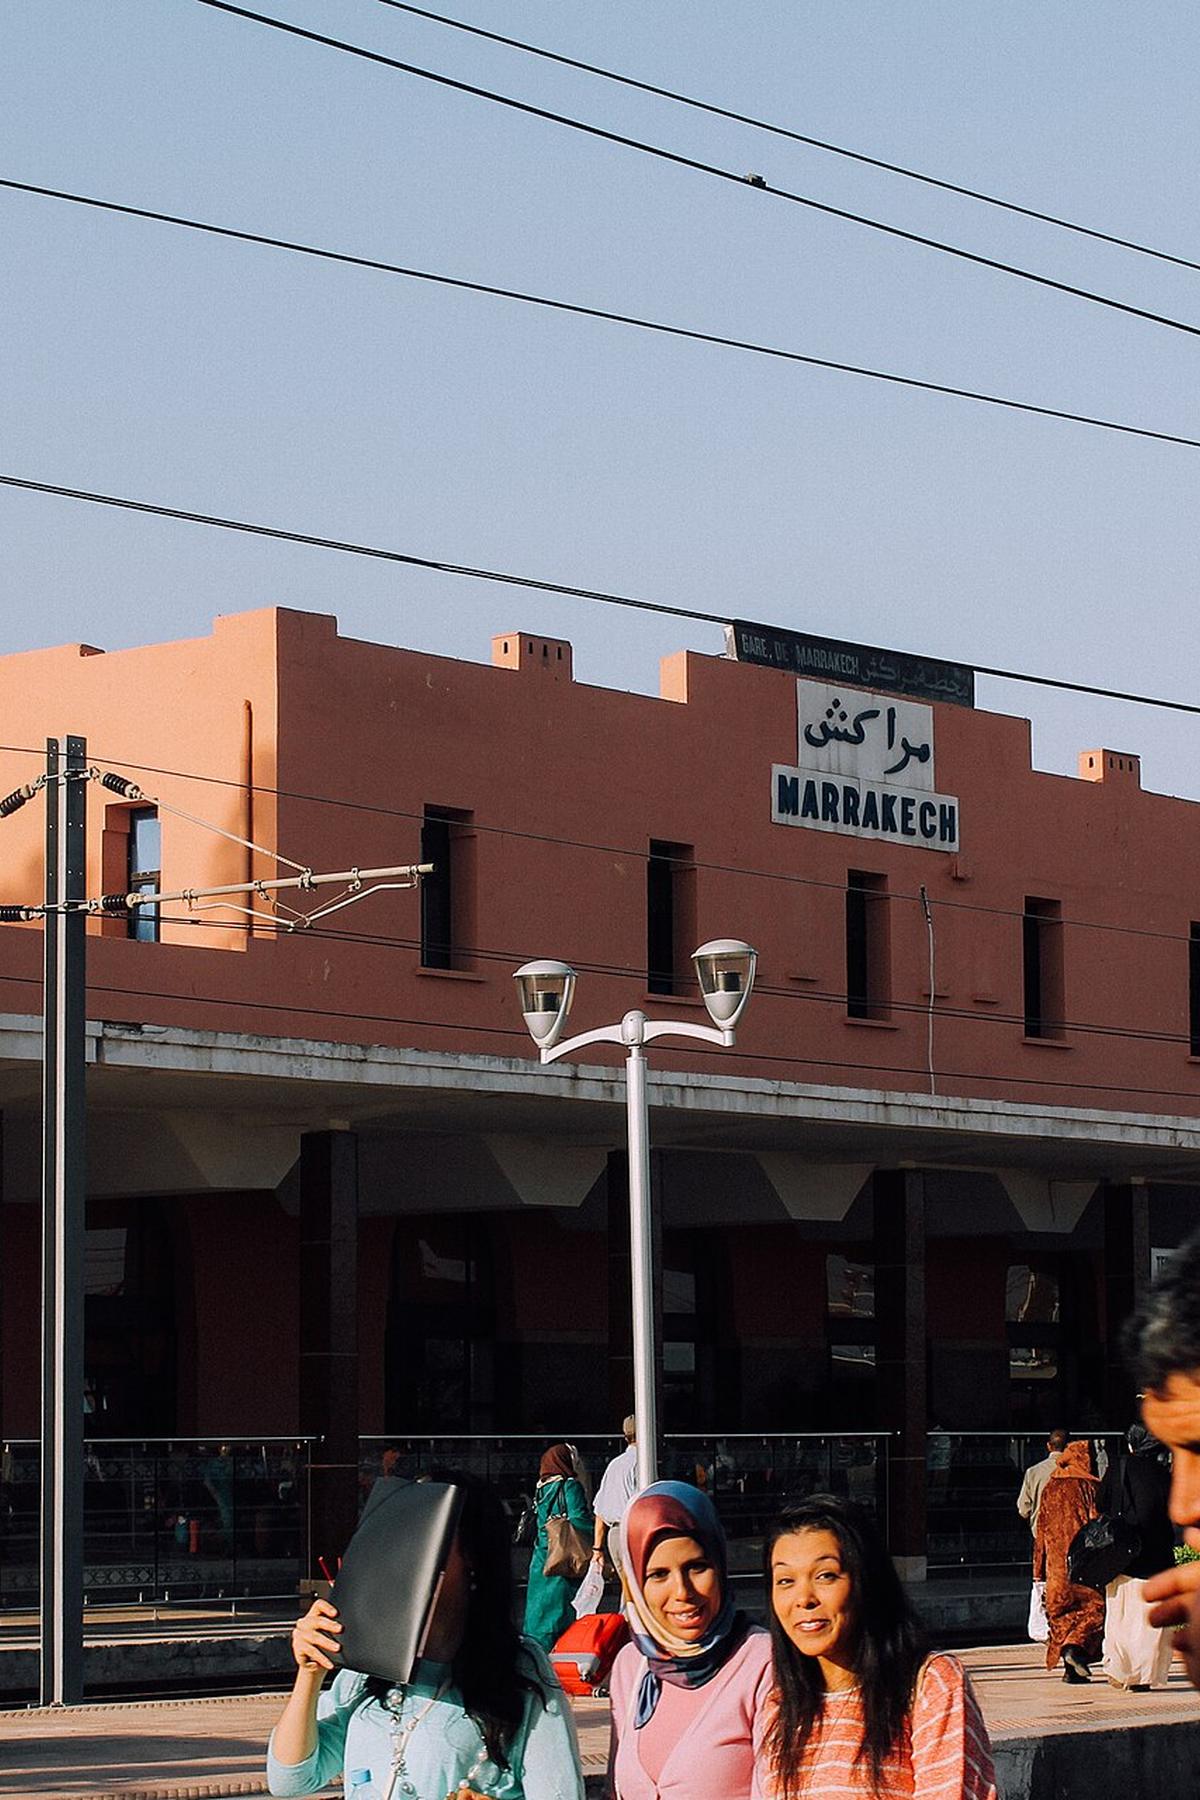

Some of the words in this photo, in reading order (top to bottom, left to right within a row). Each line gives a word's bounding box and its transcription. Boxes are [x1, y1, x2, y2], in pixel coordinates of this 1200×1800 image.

[796, 645, 859, 675] MARRAKECH
[804, 698, 930, 774] مراكش
[778, 774, 956, 843] MARRAKECH
